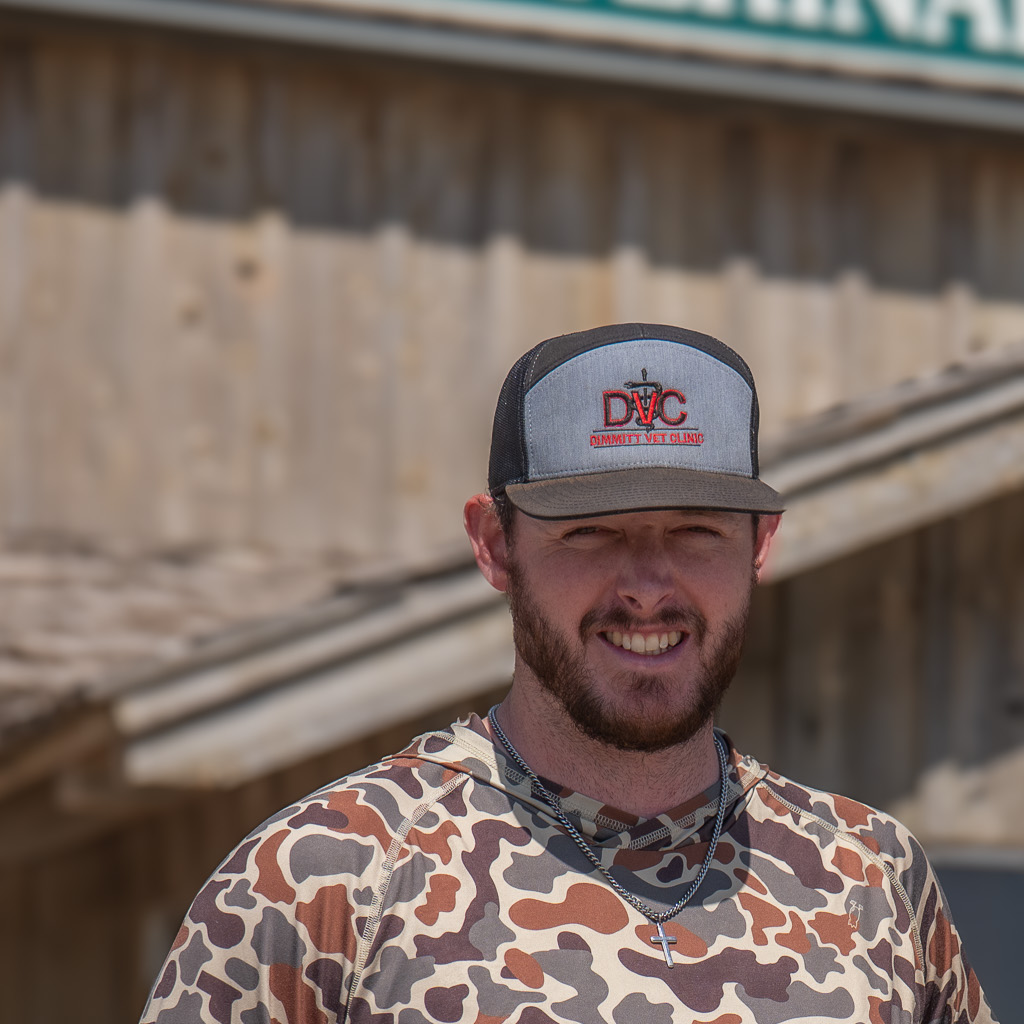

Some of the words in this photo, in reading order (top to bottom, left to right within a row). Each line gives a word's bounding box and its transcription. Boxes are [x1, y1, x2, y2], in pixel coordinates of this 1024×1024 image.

[603, 389, 687, 427] DVC
[590, 434, 641, 446] DIMMITT
[644, 433, 667, 443] VET
[670, 433, 704, 444] CLINIC
